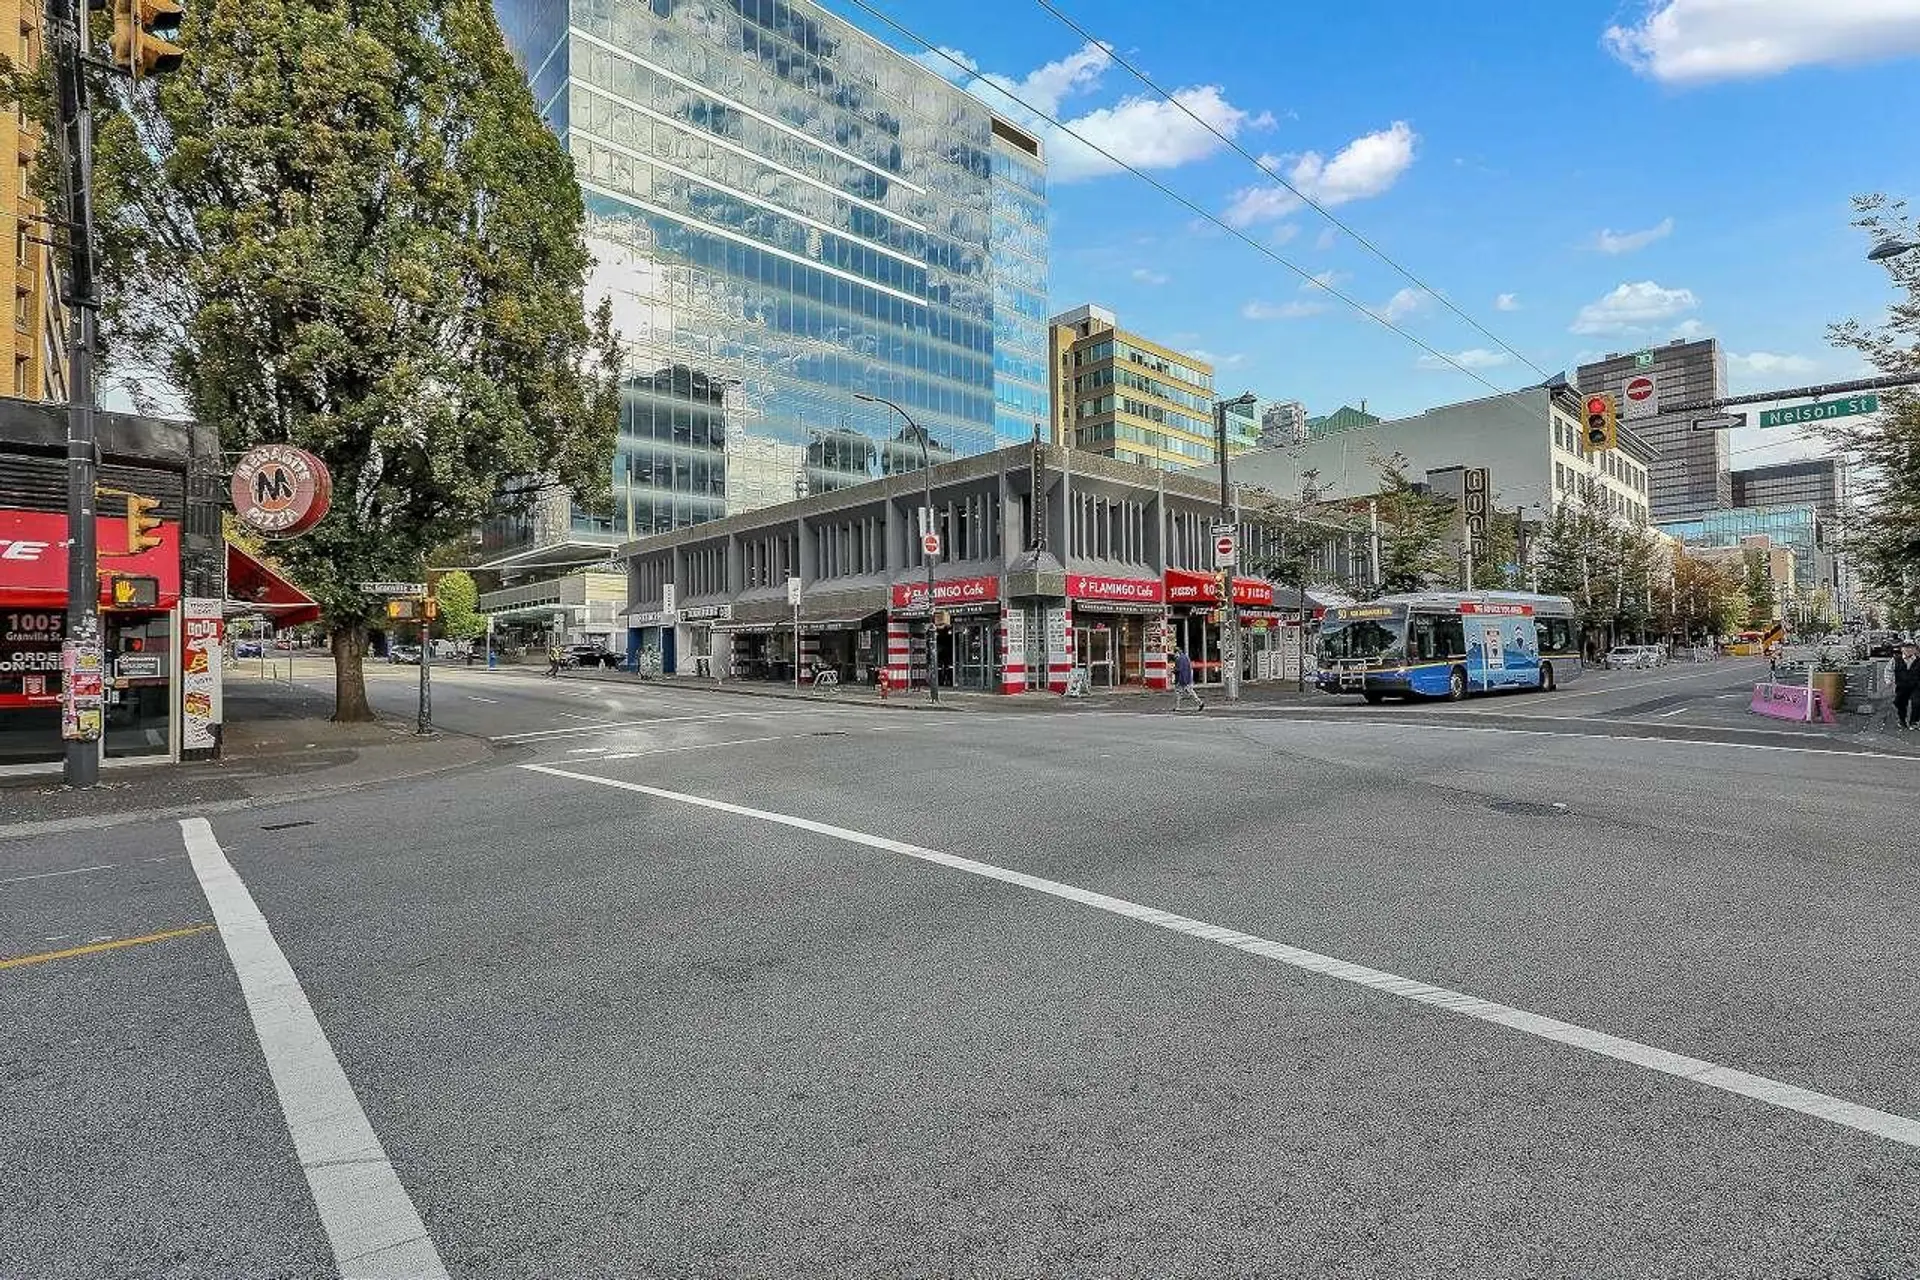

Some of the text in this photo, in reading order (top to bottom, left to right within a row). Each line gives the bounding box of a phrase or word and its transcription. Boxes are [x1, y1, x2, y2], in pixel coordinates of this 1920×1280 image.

[1770, 400, 1867, 424] Nelson St
[258, 467, 293, 504] M
[0, 540, 50, 560] E
[963, 582, 984, 596] Cafe
[1089, 582, 1153, 597] FLAMINGO Cafe
[7, 613, 62, 632] 1005
[6, 632, 49, 642] Granville
